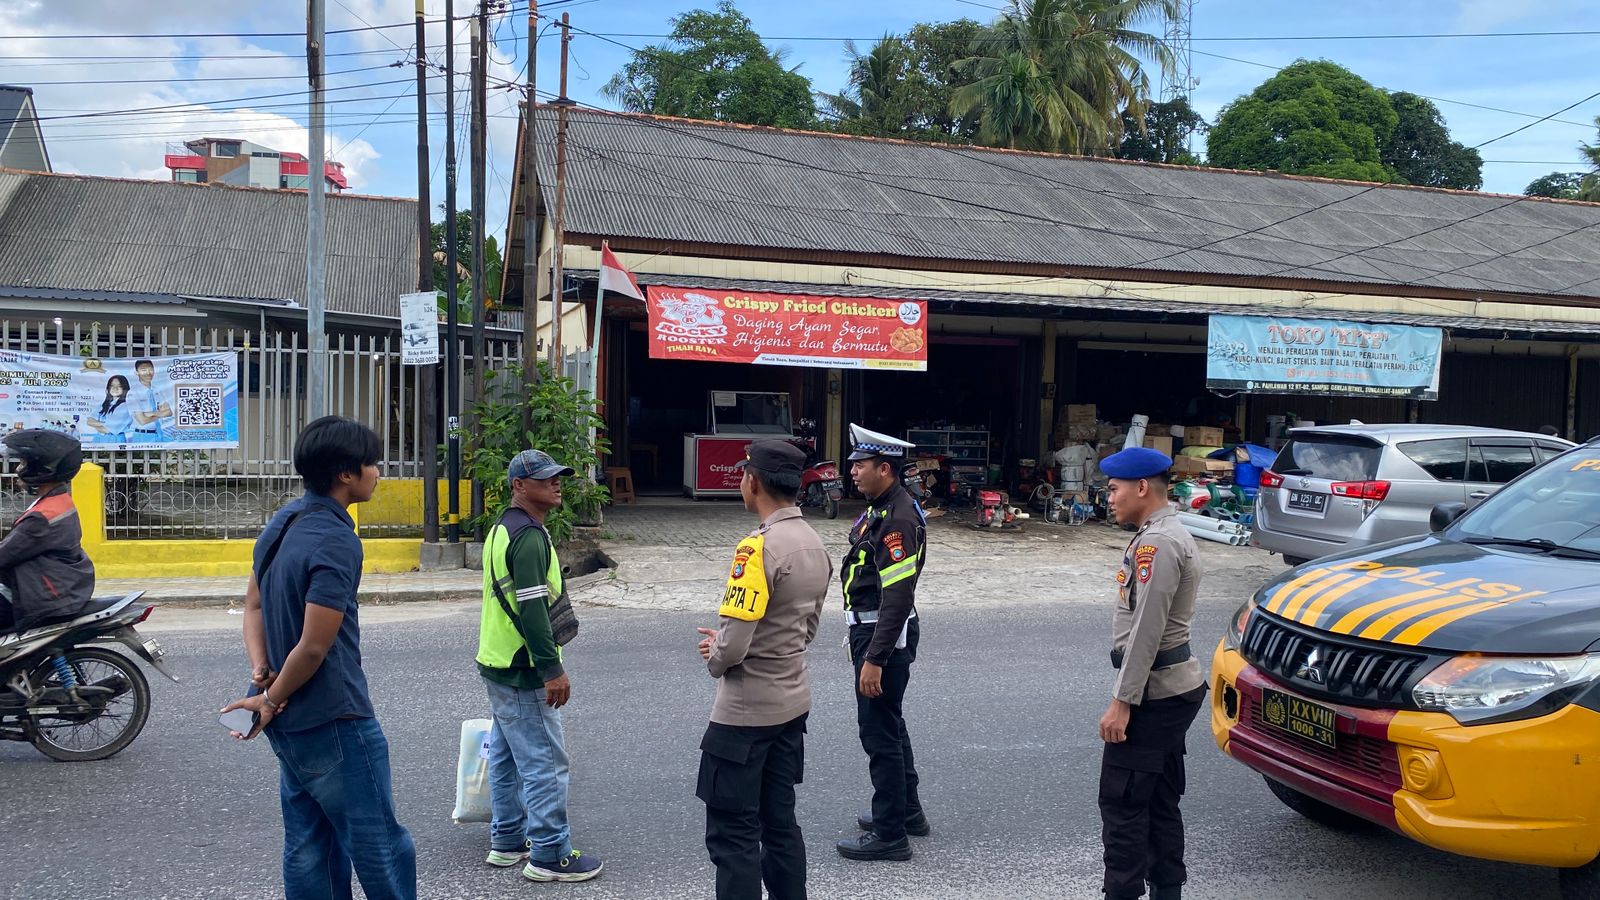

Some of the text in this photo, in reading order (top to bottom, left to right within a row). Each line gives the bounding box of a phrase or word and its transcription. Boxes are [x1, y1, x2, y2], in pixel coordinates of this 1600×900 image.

[724, 296, 897, 317] Crispy Fried Chicken
[660, 323, 726, 337] ROCKY
[733, 314, 783, 335] Daging
[789, 316, 832, 337] Ayam
[656, 334, 727, 345] ROOSTER
[733, 332, 888, 353] Higienis dan Bermutu
[1267, 325, 1325, 345] TOKO
[667, 344, 718, 355] TIMAH RAYA
[1257, 346, 1284, 355] MENJUAL
[1285, 347, 1319, 356] PERALATAN
[1359, 351, 1390, 361] PERALATAN
[0, 370, 72, 380] DIMULAI BULAN
[167, 365, 195, 373] Masuk
[170, 371, 228, 380] Code di bawah
[1328, 560, 1548, 606] POLISI
[1291, 699, 1333, 728] XXVIII
